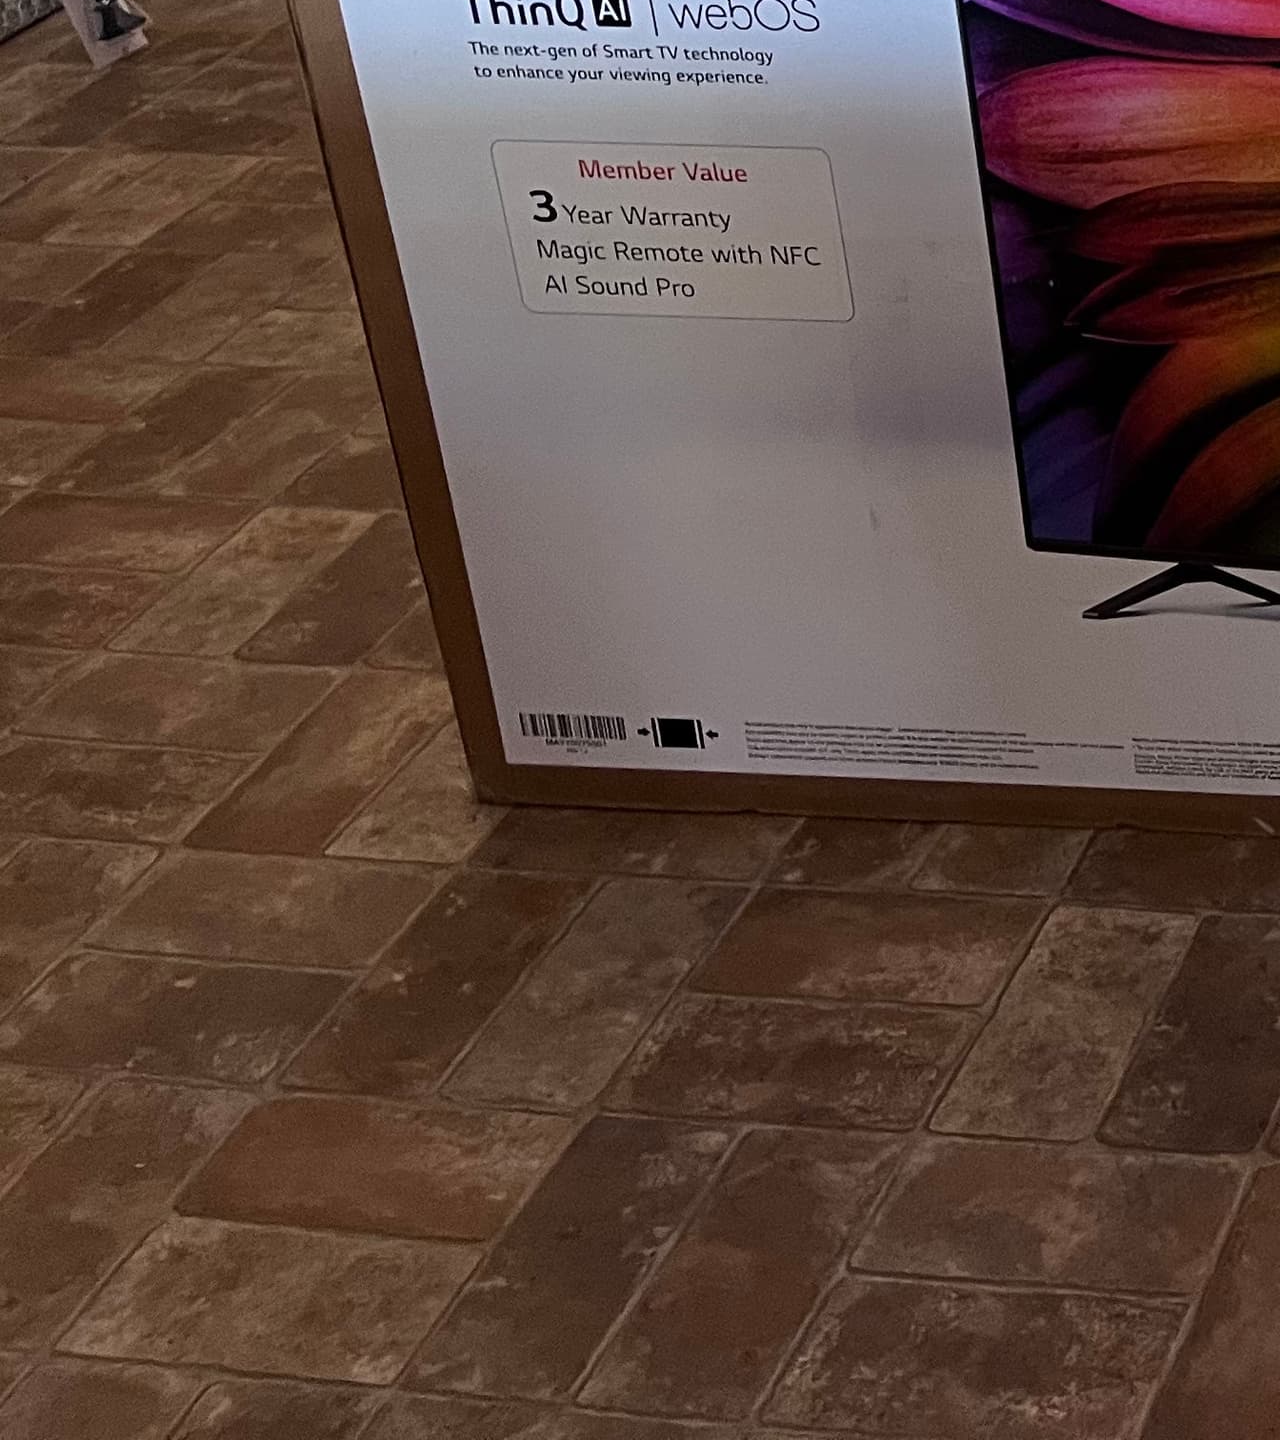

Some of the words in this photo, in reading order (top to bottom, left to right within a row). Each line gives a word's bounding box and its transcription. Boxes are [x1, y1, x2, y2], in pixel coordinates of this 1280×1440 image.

[468, 41, 500, 57] The
[503, 43, 578, 61] next-gen
[582, 43, 598, 58] of
[603, 44, 652, 60] Smart
[656, 45, 677, 60] TV
[683, 46, 773, 67] technology
[474, 66, 492, 79] to
[496, 65, 564, 82] enhance
[568, 69, 604, 85] your
[609, 67, 672, 86] viewing
[676, 69, 769, 87] experience.
[578, 159, 675, 181] Member
[683, 162, 748, 183] Value
[529, 190, 557, 223] 3
[562, 205, 613, 225] Year
[620, 206, 731, 233] Warranty
[536, 239, 606, 265] Magic
[613, 241, 704, 263] Remote
[712, 244, 762, 265] with
[771, 245, 821, 266] NFC
[545, 275, 567, 294] AI
[575, 276, 648, 297] Sound
[656, 278, 695, 298] Pro
